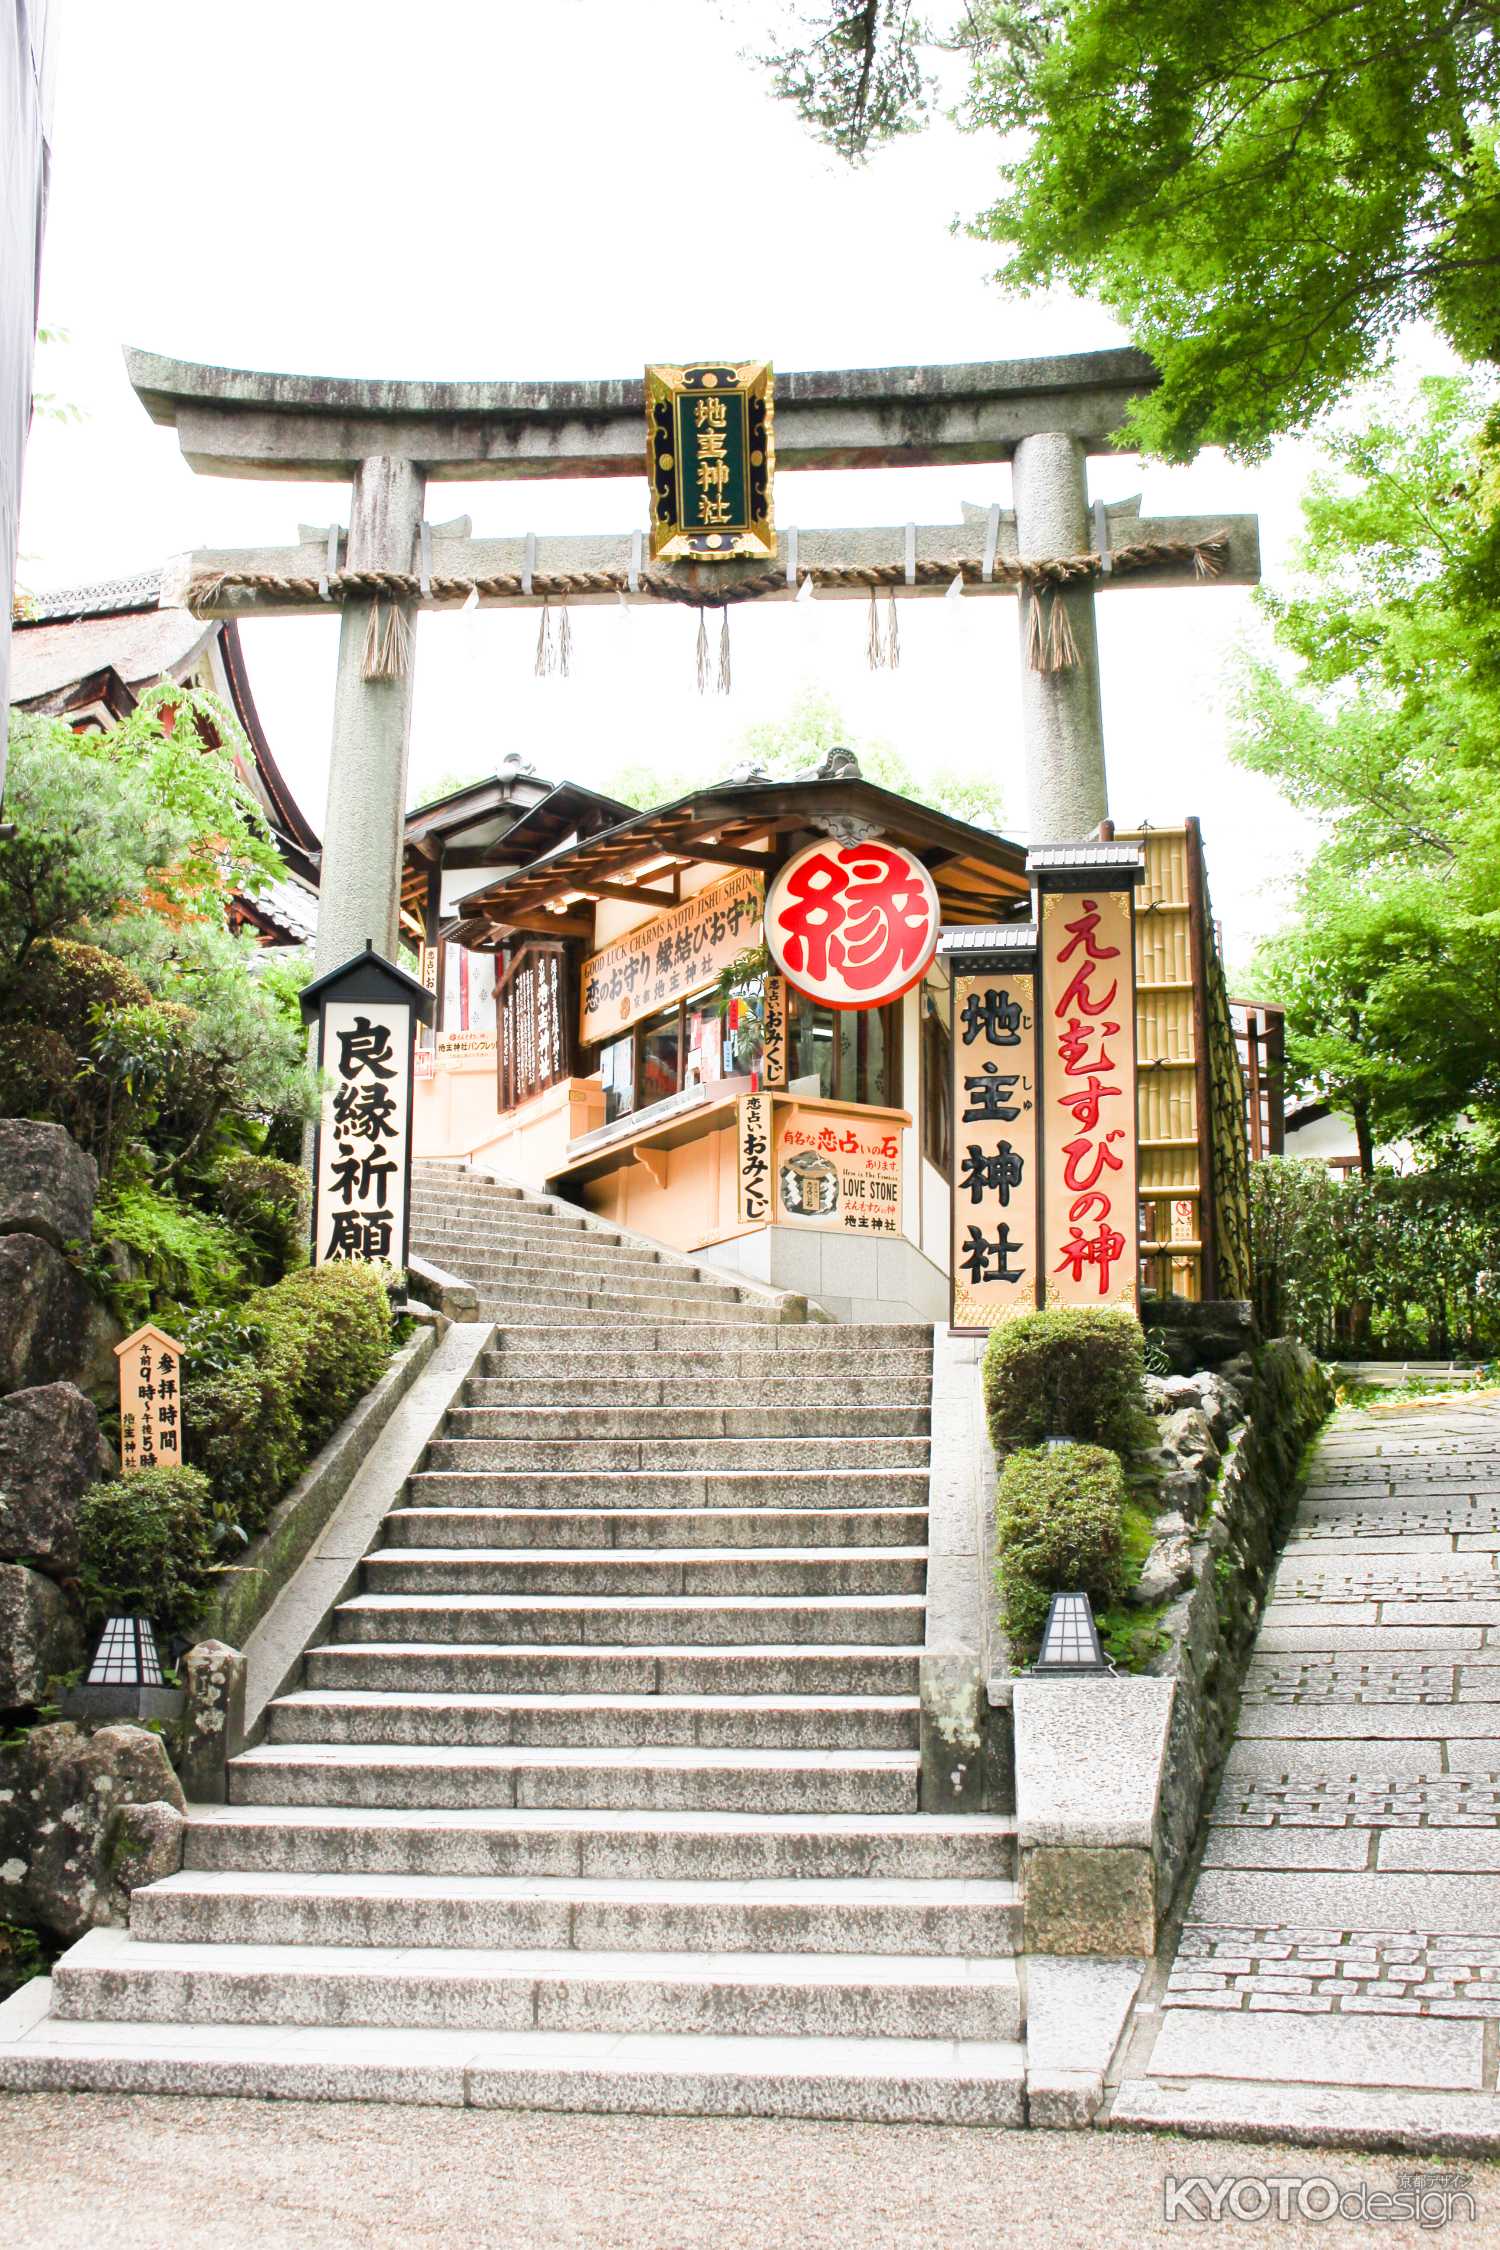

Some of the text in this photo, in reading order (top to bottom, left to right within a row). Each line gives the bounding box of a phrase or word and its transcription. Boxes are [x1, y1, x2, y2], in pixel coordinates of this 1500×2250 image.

[695, 397, 733, 525] 地主神社
[584, 956, 605, 978] GOOD
[607, 944, 627, 967] LUCK
[630, 924, 665, 953] CHARMS
[667, 907, 694, 934] KYOTO
[697, 889, 721, 919] JISHU
[778, 842, 928, 990] 縁
[585, 951, 651, 1015] 恋のお守り
[765, 979, 784, 1082] 恋占いおみくじ
[324, 1017, 400, 1268] 良縁祈願
[959, 989, 1026, 1285] 地主神社
[1054, 900, 1126, 1295] えんむすびの神
[742, 1097, 769, 1219] 恋占いおみくじ
[843, 1179, 898, 1202] LOVE STONE
[845, 1215, 896, 1231] 地主神社
[123, 1413, 136, 1468] 地主神社
[157, 1353, 178, 1451] 参拝時間
